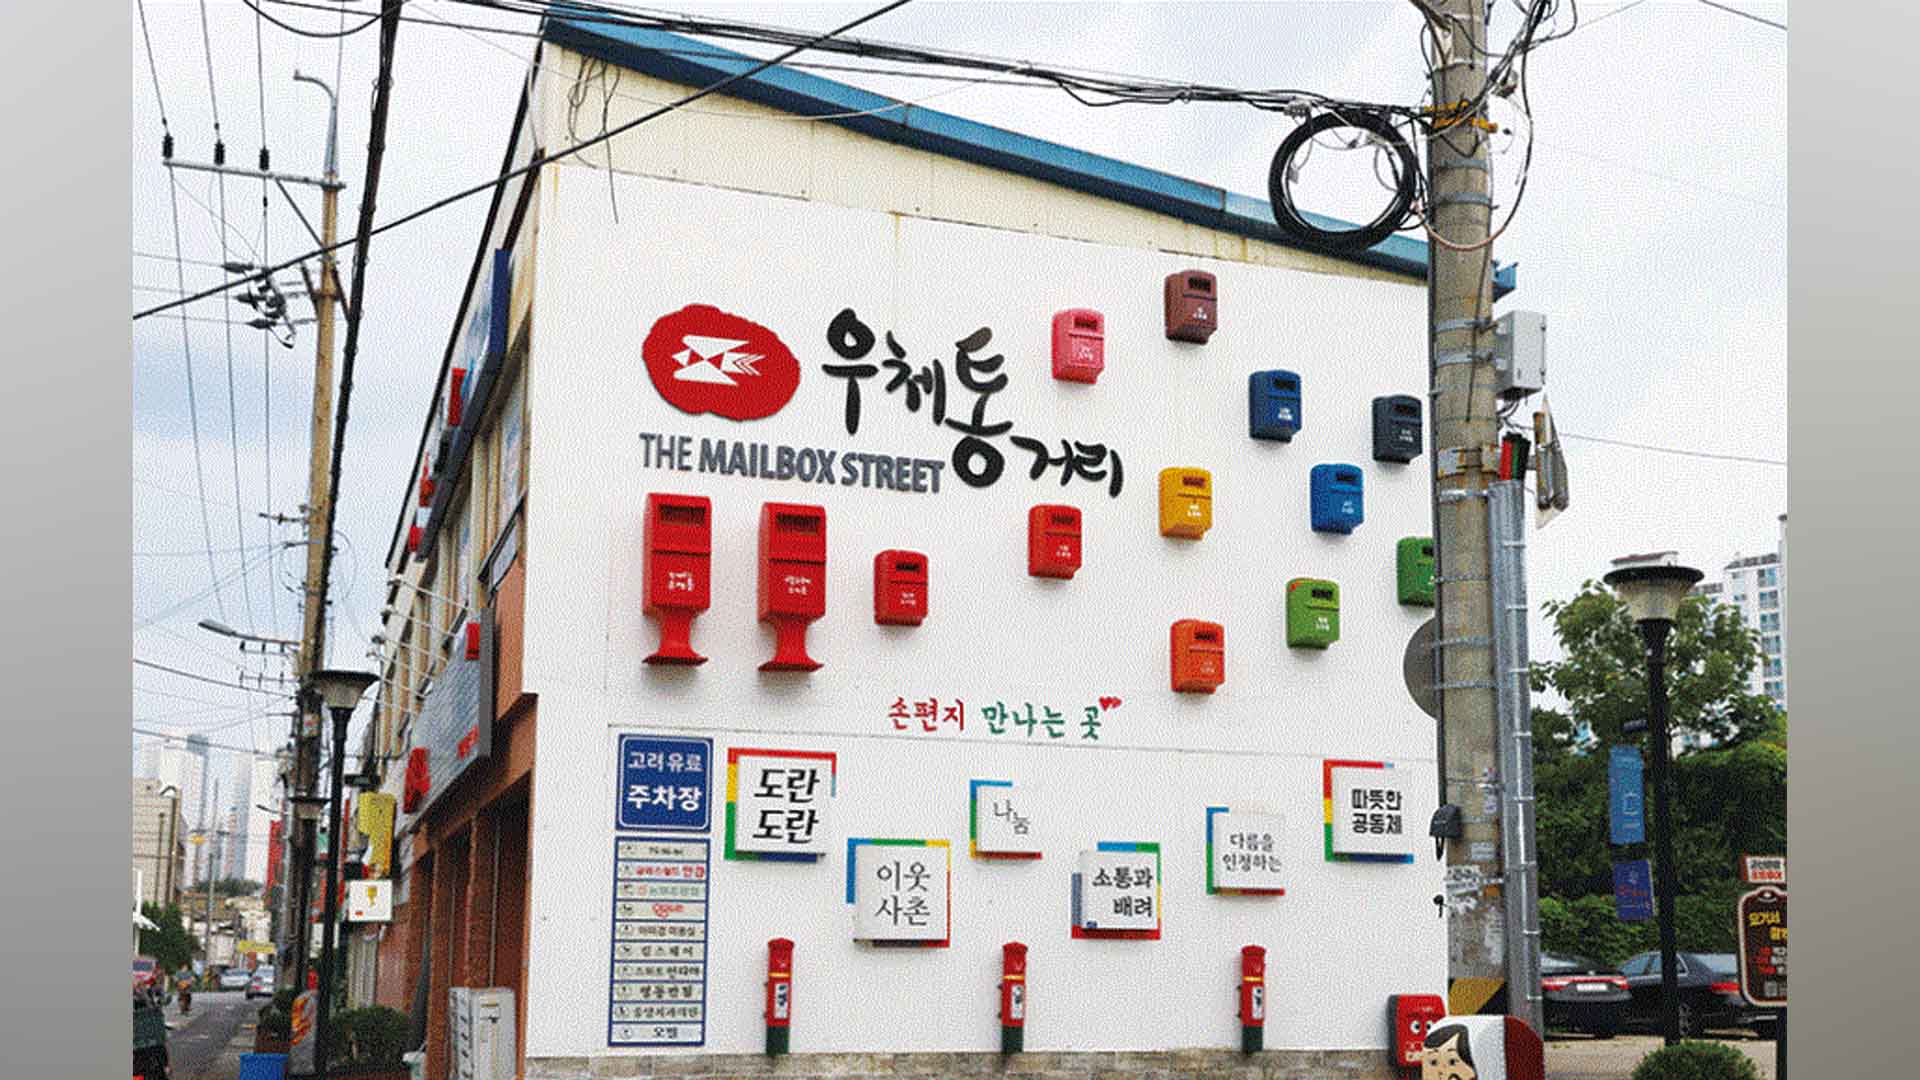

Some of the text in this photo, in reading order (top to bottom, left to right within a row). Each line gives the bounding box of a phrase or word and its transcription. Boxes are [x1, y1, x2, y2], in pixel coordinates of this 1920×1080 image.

[822, 308, 1124, 498] 우체통 거리
[639, 432, 946, 494] THE MAILBOX STREET
[888, 697, 1101, 740] 손편지 만나는 곳
[628, 752, 704, 772] 고려 유료
[627, 785, 702, 812] 주차장
[754, 769, 820, 804] 도란
[1352, 788, 1402, 811] 따뜻한
[753, 809, 819, 844] 도란
[993, 800, 1030, 835] 나눔
[1353, 812, 1402, 834] 공동체
[1230, 833, 1275, 852] 다름을
[876, 862, 931, 892] 이웃
[1222, 854, 1282, 873] 인정하는
[1092, 867, 1153, 889] 소통과
[875, 895, 931, 927] 사촌
[1113, 896, 1152, 918] 배려
